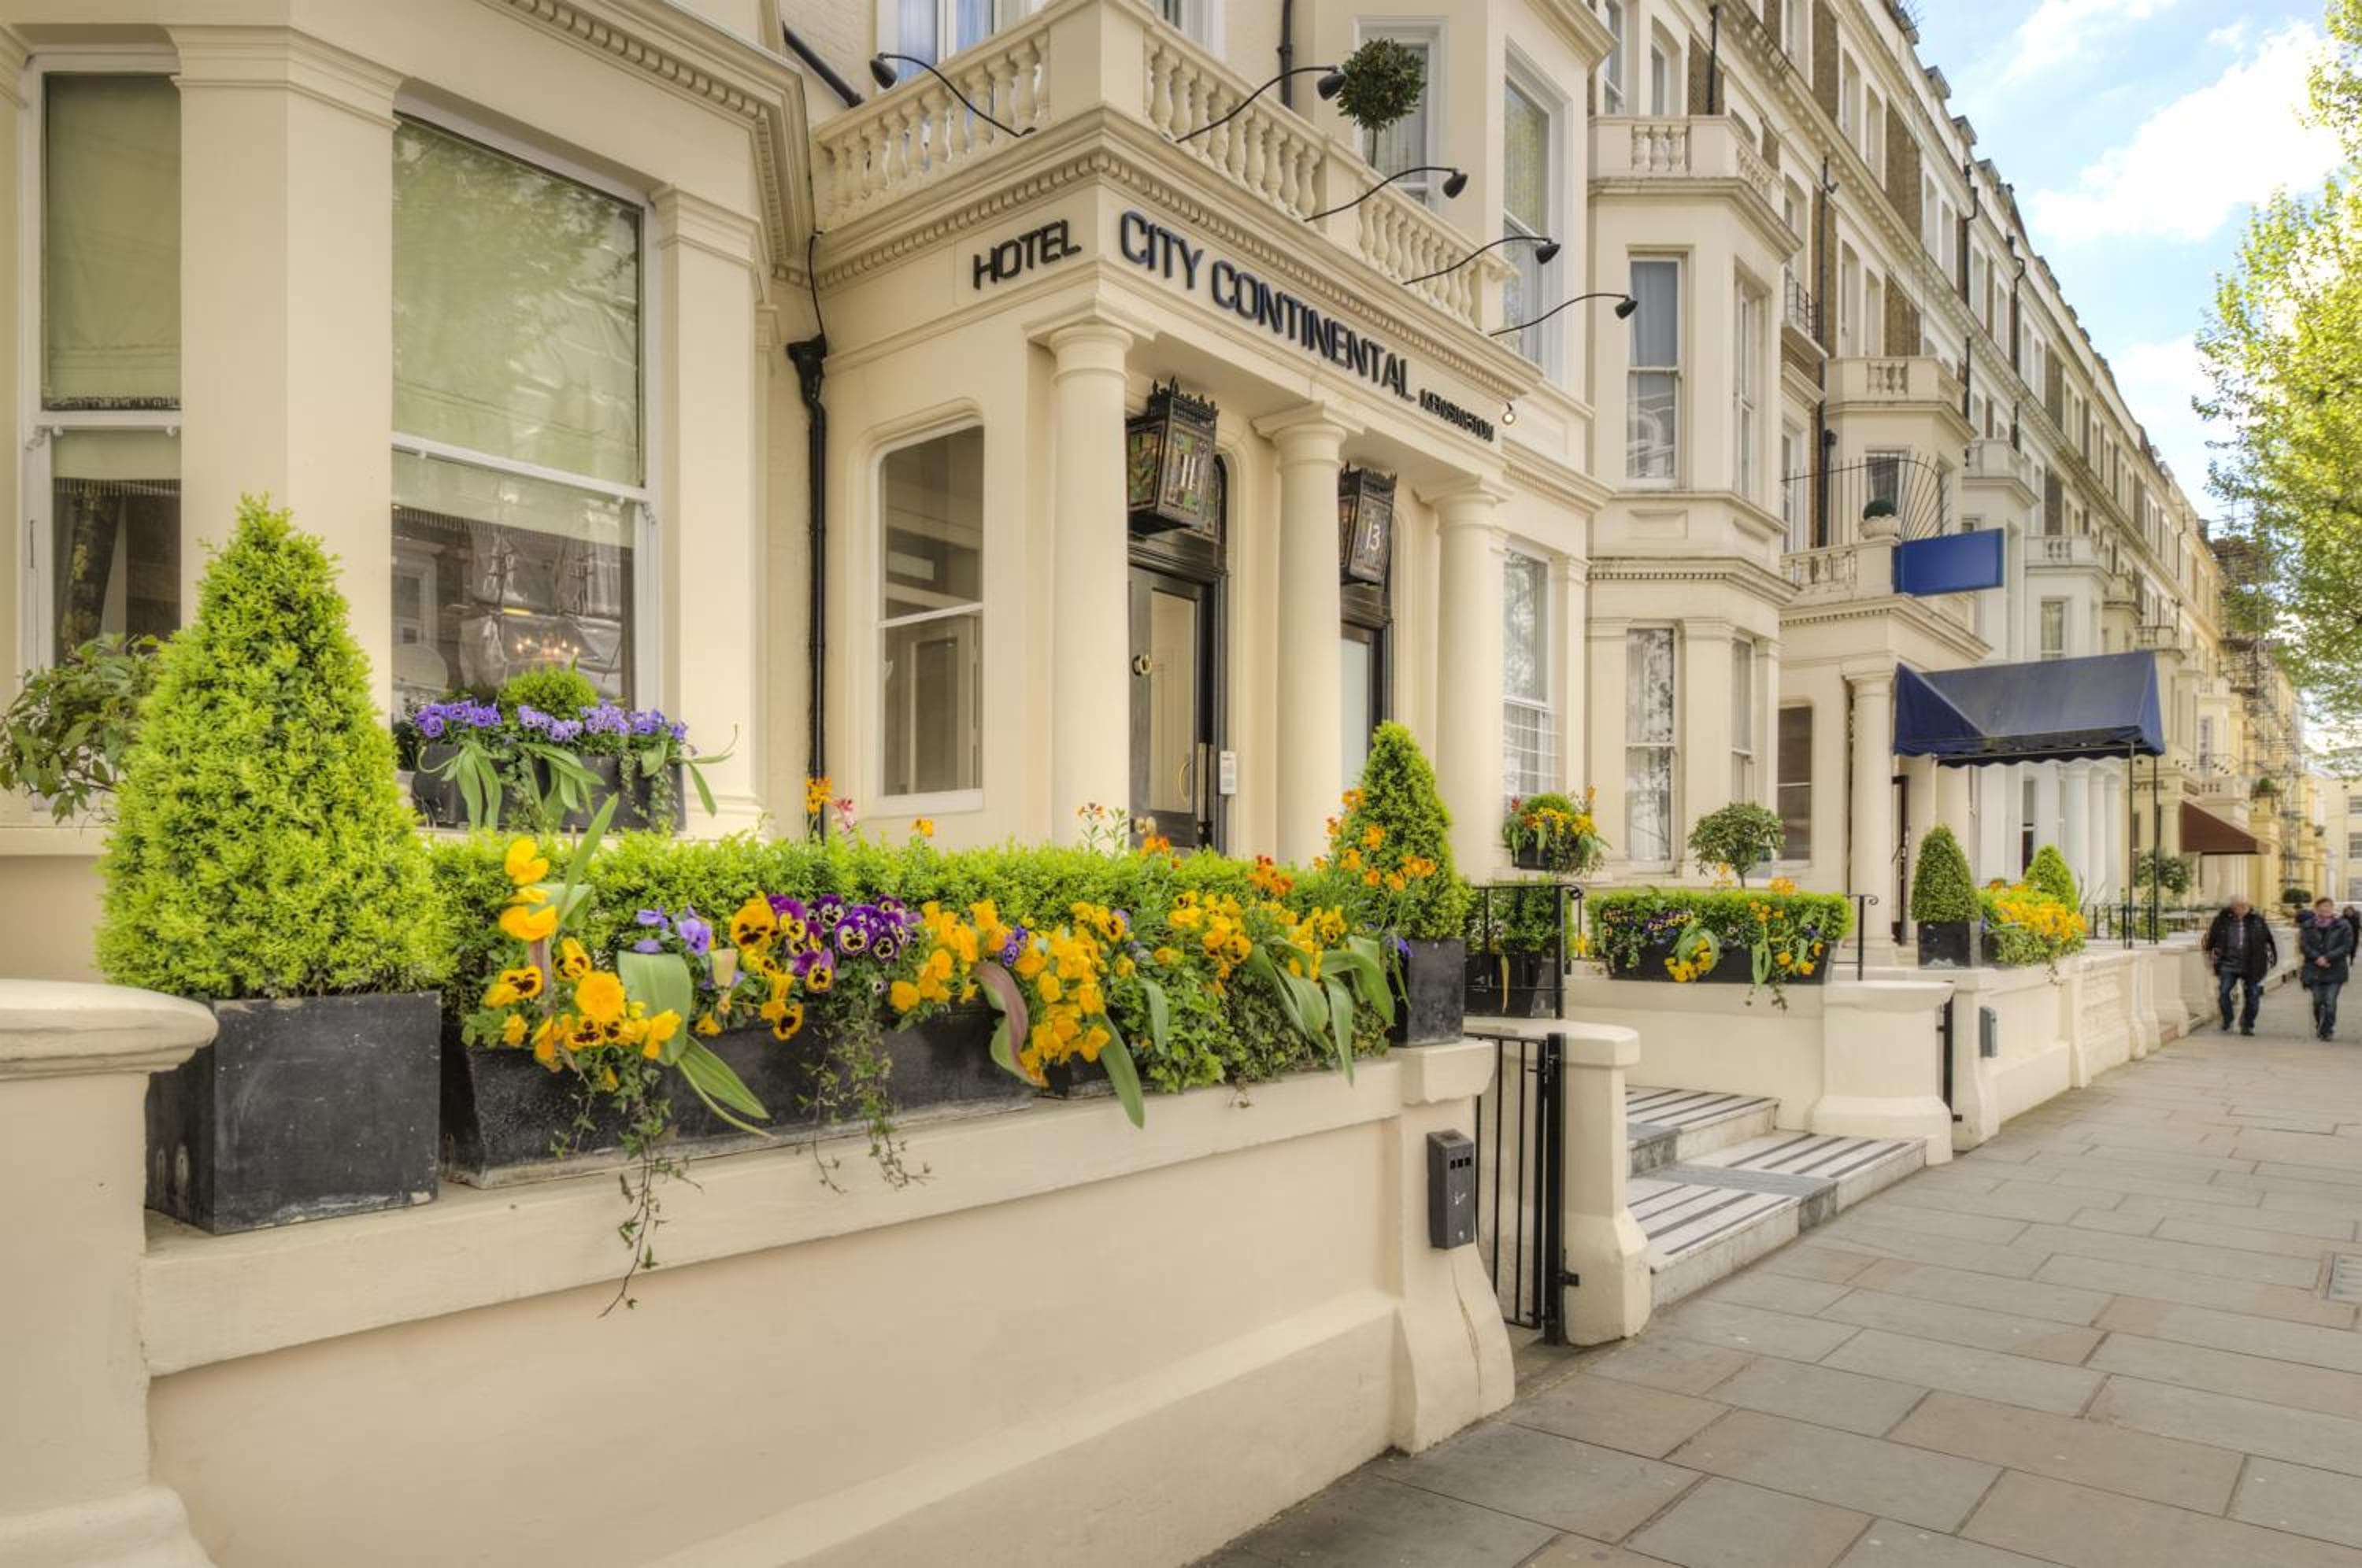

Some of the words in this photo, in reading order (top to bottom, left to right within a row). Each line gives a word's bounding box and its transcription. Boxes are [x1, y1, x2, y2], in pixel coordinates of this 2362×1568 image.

[972, 220, 1082, 290] HOTEL
[1120, 210, 1205, 290] CITY
[1212, 260, 1416, 401] CONTINENTAL
[1181, 454, 1196, 490] 11
[1366, 522, 1380, 551] 13
